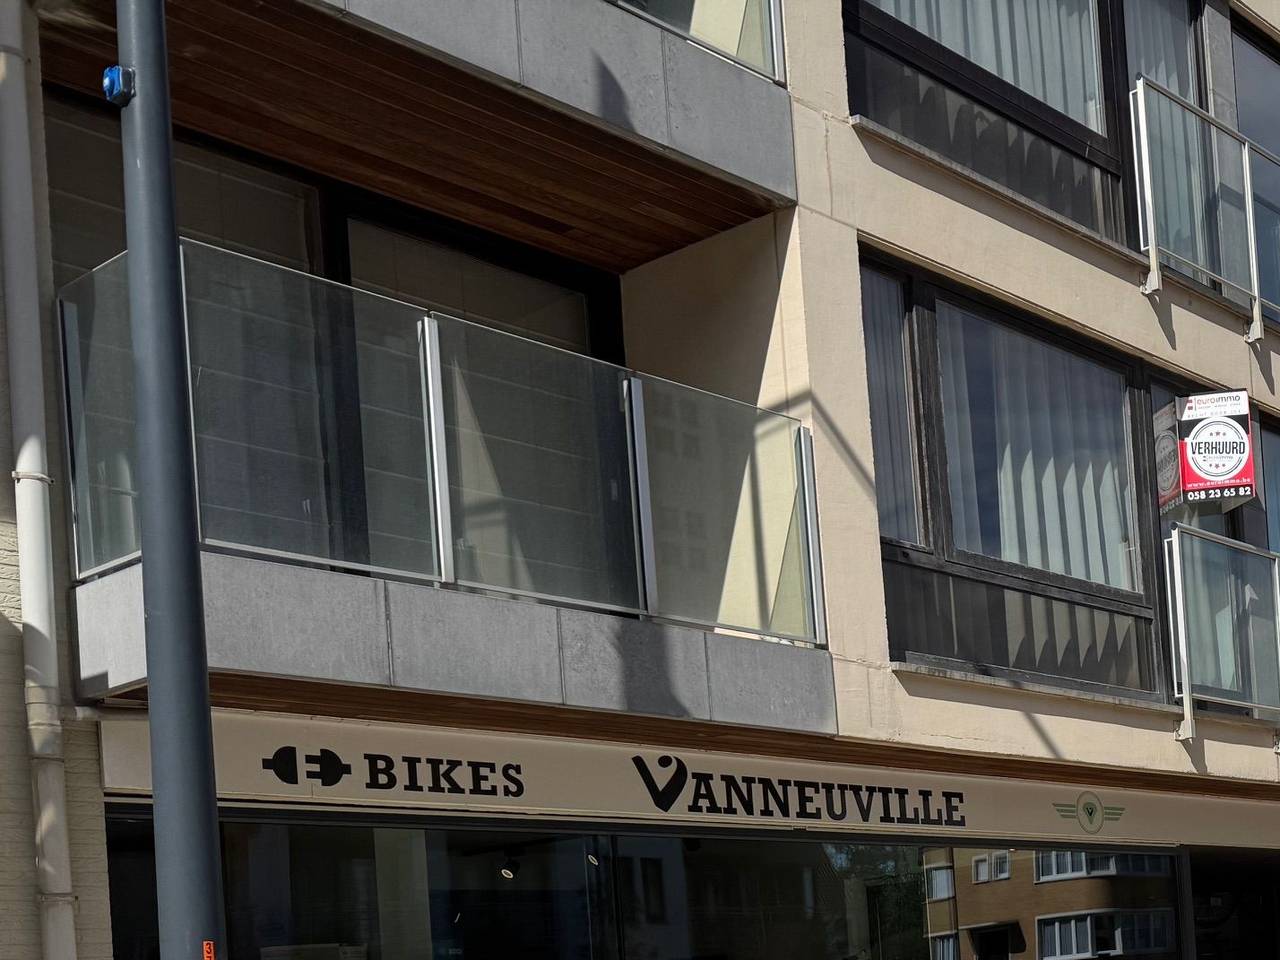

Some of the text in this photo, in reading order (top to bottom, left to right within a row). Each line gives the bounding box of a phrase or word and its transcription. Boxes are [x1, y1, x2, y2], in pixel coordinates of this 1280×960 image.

[1190, 441, 1246, 455] VERHUURD
[1188, 486, 1251, 500] 058 23 65 82
[363, 753, 525, 798] BIKES
[631, 755, 966, 827] VANNEUVILLE
